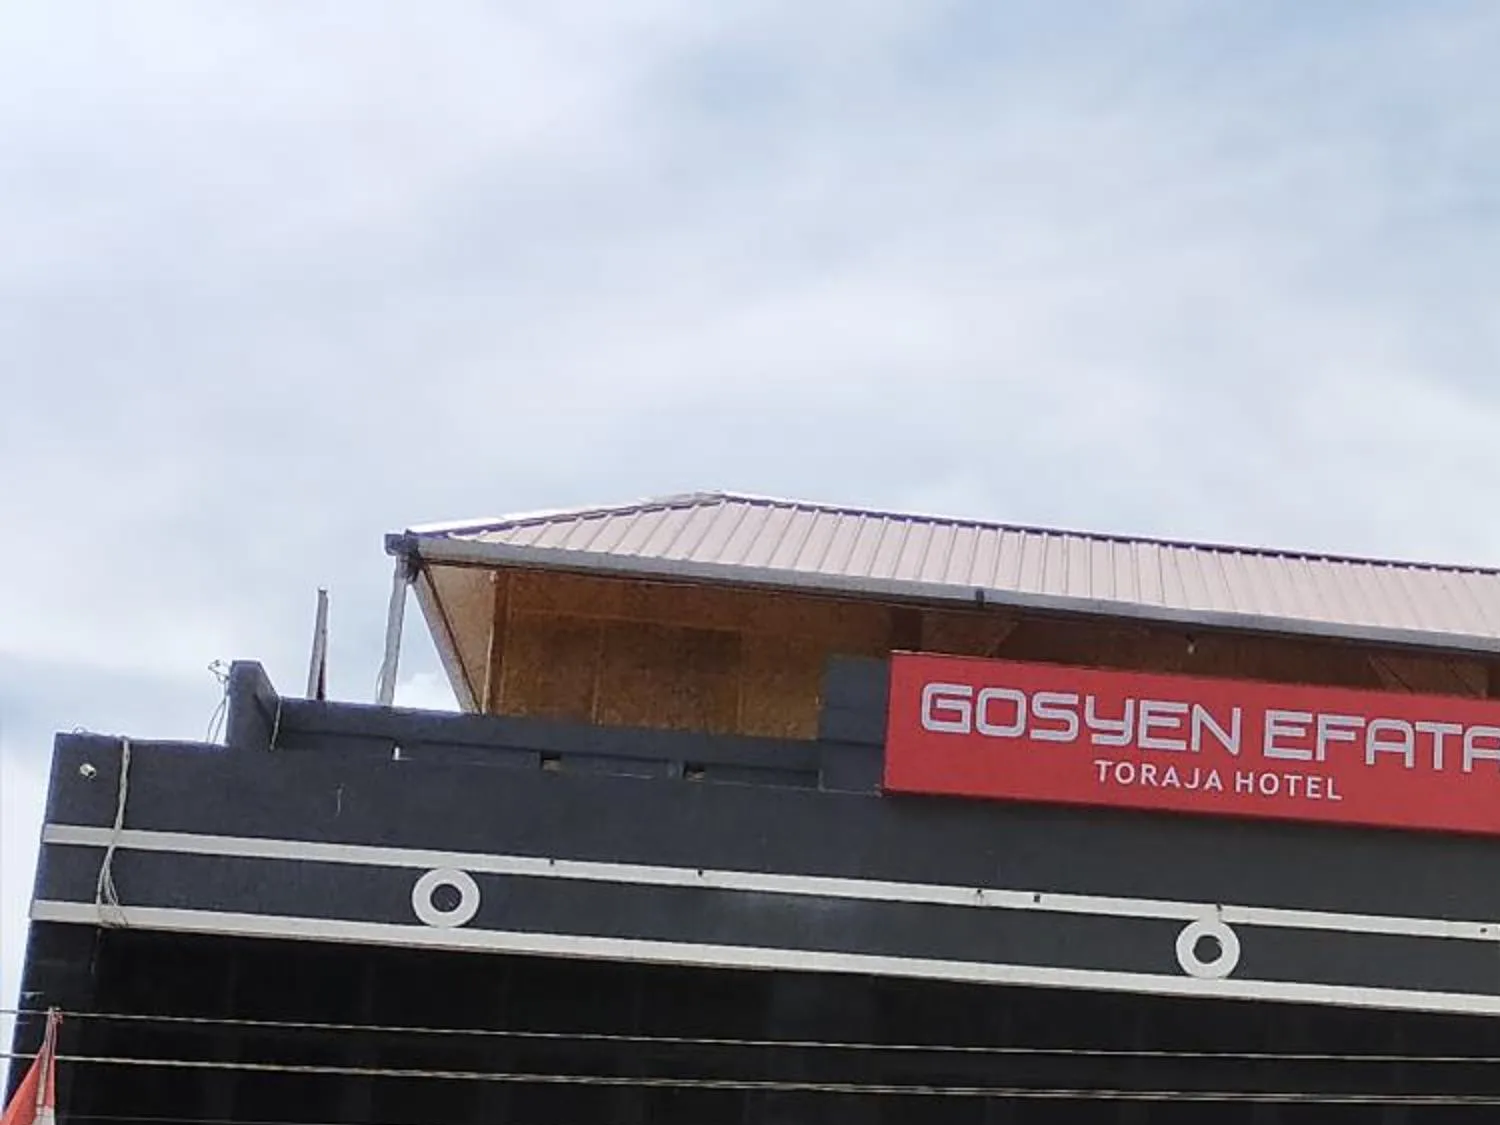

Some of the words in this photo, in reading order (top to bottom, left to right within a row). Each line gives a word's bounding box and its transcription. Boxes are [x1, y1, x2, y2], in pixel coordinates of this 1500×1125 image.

[921, 683, 1241, 757] GOSYEN
[1093, 760, 1224, 793] TORAJA
[1235, 771, 1343, 801] HOTEL
